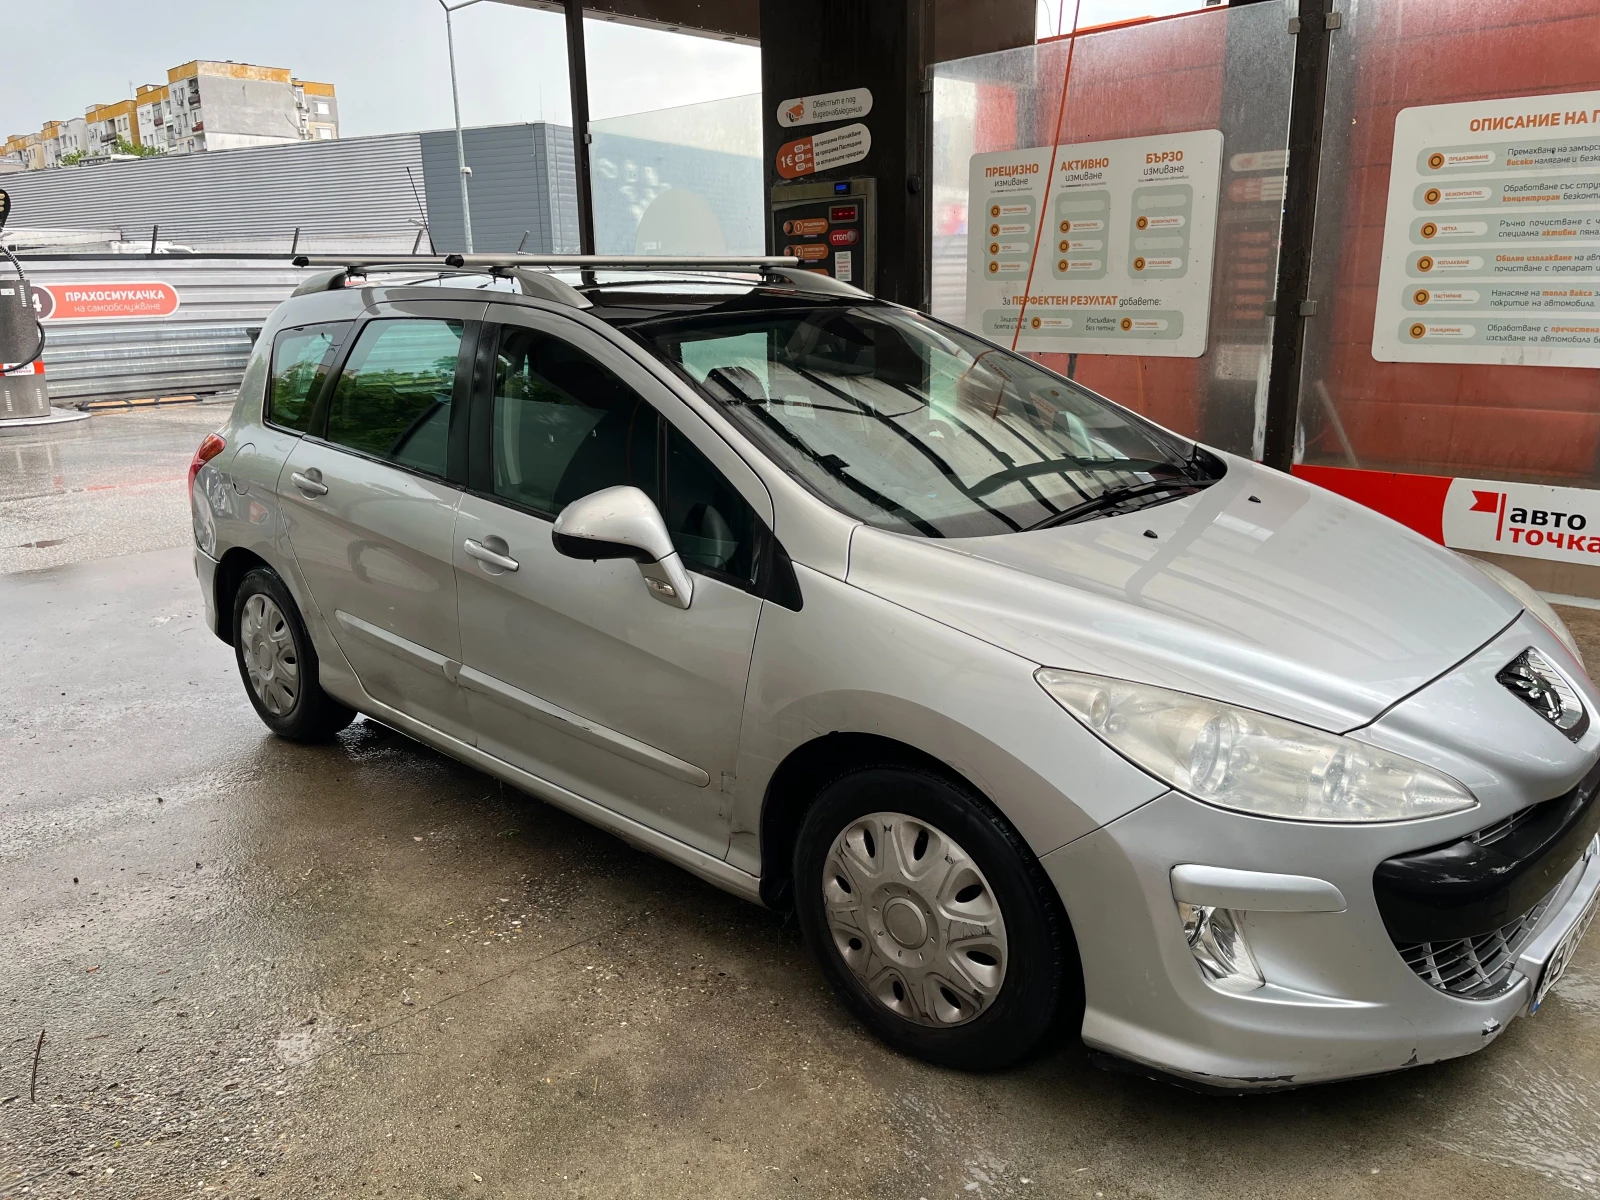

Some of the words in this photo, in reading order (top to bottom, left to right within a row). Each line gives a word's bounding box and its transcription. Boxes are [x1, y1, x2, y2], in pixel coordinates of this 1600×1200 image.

[812, 98, 840, 109] Обектът
[845, 96, 857, 105] под
[1469, 112, 1561, 132] ОПИСАНИЕ
[1564, 110, 1588, 125] НА
[1507, 146, 1556, 157] Премахване
[781, 154, 794, 168] 1€
[1146, 150, 1184, 164] БЪРЗО
[1448, 154, 1489, 162] ПРЕДИЗМИВАНЕ
[1506, 158, 1534, 166] високо
[1534, 157, 1570, 165] налягане
[1060, 157, 1109, 172] АКТИВНО
[985, 163, 1039, 178] ПРЕЦИЗНО
[1143, 164, 1185, 176] измиване
[1065, 171, 1103, 182] измиване
[994, 178, 1029, 187] измиване
[1503, 183, 1558, 192] Обработване
[1502, 194, 1561, 203] концентриран
[1500, 219, 1526, 228] Ръчно
[1529, 218, 1583, 228] почистване
[1498, 230, 1539, 238] специална
[1541, 228, 1577, 237] активна
[1495, 254, 1525, 262] Обилно
[1526, 253, 1573, 262] изплакване
[1494, 264, 1542, 273] почистване
[1552, 265, 1593, 273] препарат
[65, 290, 165, 302] ПРАХОСМУКАЧКА
[1491, 289, 1530, 297] Нанасяне
[1569, 288, 1593, 297] вакса
[32, 293, 42, 312] 4
[1002, 297, 1011, 306] За
[1012, 295, 1069, 306] ПЕРФЕКТЕН
[1070, 295, 1118, 306] РЕЗУЛТАТ
[1119, 297, 1161, 307] добавете:
[1490, 299, 1530, 308] покритие
[1544, 299, 1596, 307] автомобила.
[74, 305, 86, 313] на
[87, 303, 161, 313] самообслужване
[1086, 316, 1117, 324] Изсъхване
[1487, 324, 1541, 333] Обработване
[1550, 325, 1600, 334] пречистена
[1486, 334, 1527, 342] изсъхване
[1540, 335, 1591, 344] автомобила
[1509, 507, 1587, 531] авто
[1508, 527, 1600, 554] точка
